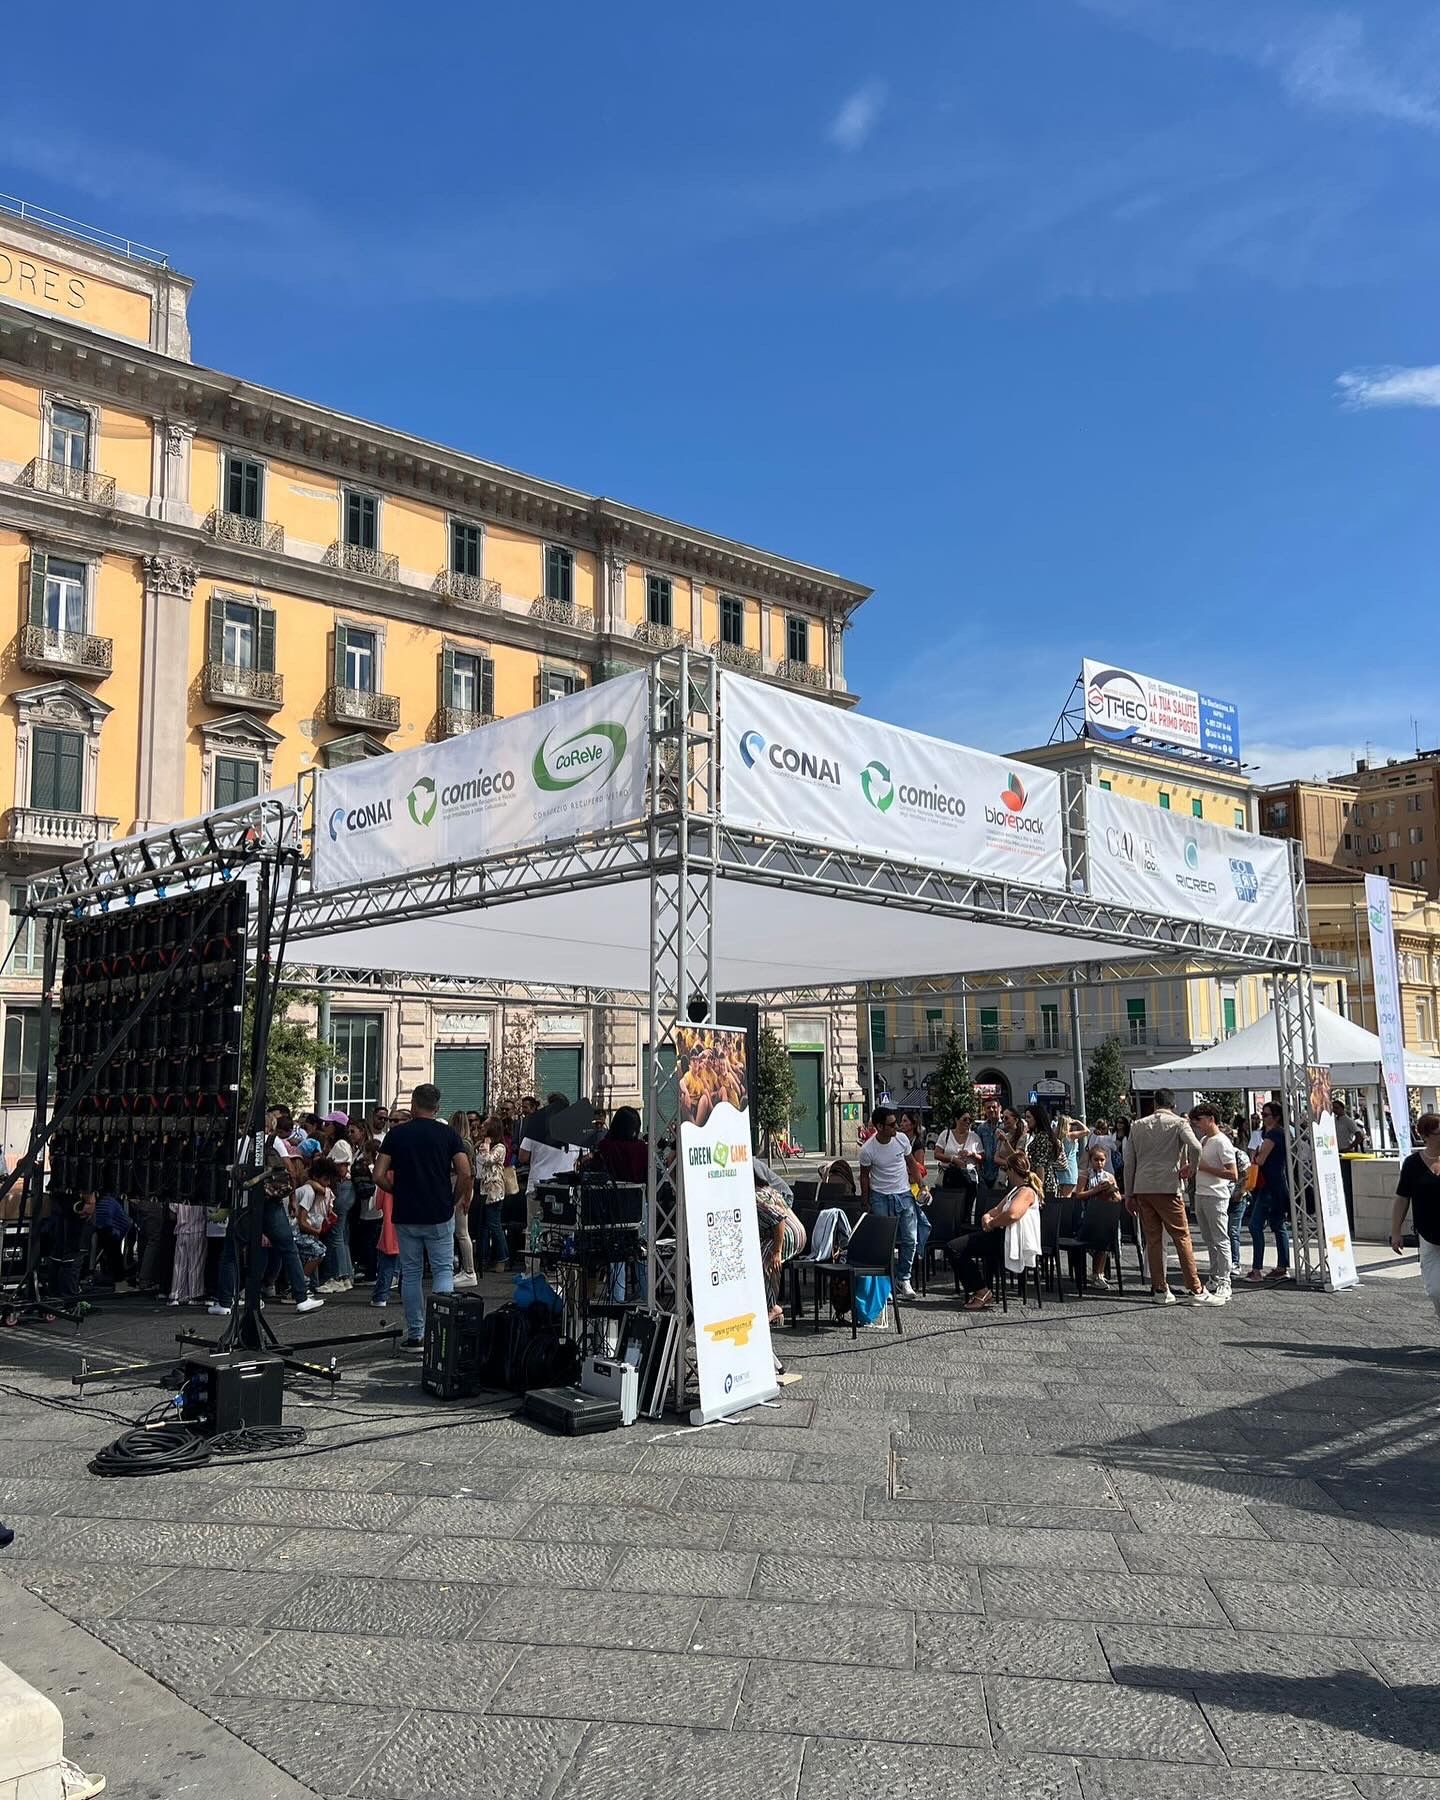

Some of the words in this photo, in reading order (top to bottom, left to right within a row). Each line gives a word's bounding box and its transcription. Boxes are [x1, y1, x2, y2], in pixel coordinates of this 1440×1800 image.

[1103, 694, 1148, 721] THEO
[1159, 695, 1172, 712] TUA
[1173, 699, 1197, 720] SALUTE
[1159, 712, 1178, 730] PRIMO
[1179, 718, 1198, 736] POSTO
[768, 743, 841, 785] CONAI
[441, 767, 515, 806] comieco
[898, 783, 966, 817] comieco
[346, 798, 393, 831] CONAI
[984, 805, 1045, 834] biorepack
[1175, 873, 1217, 895] RICREA
[688, 1146, 712, 1166] GREEN
[730, 1144, 749, 1163] GAME
